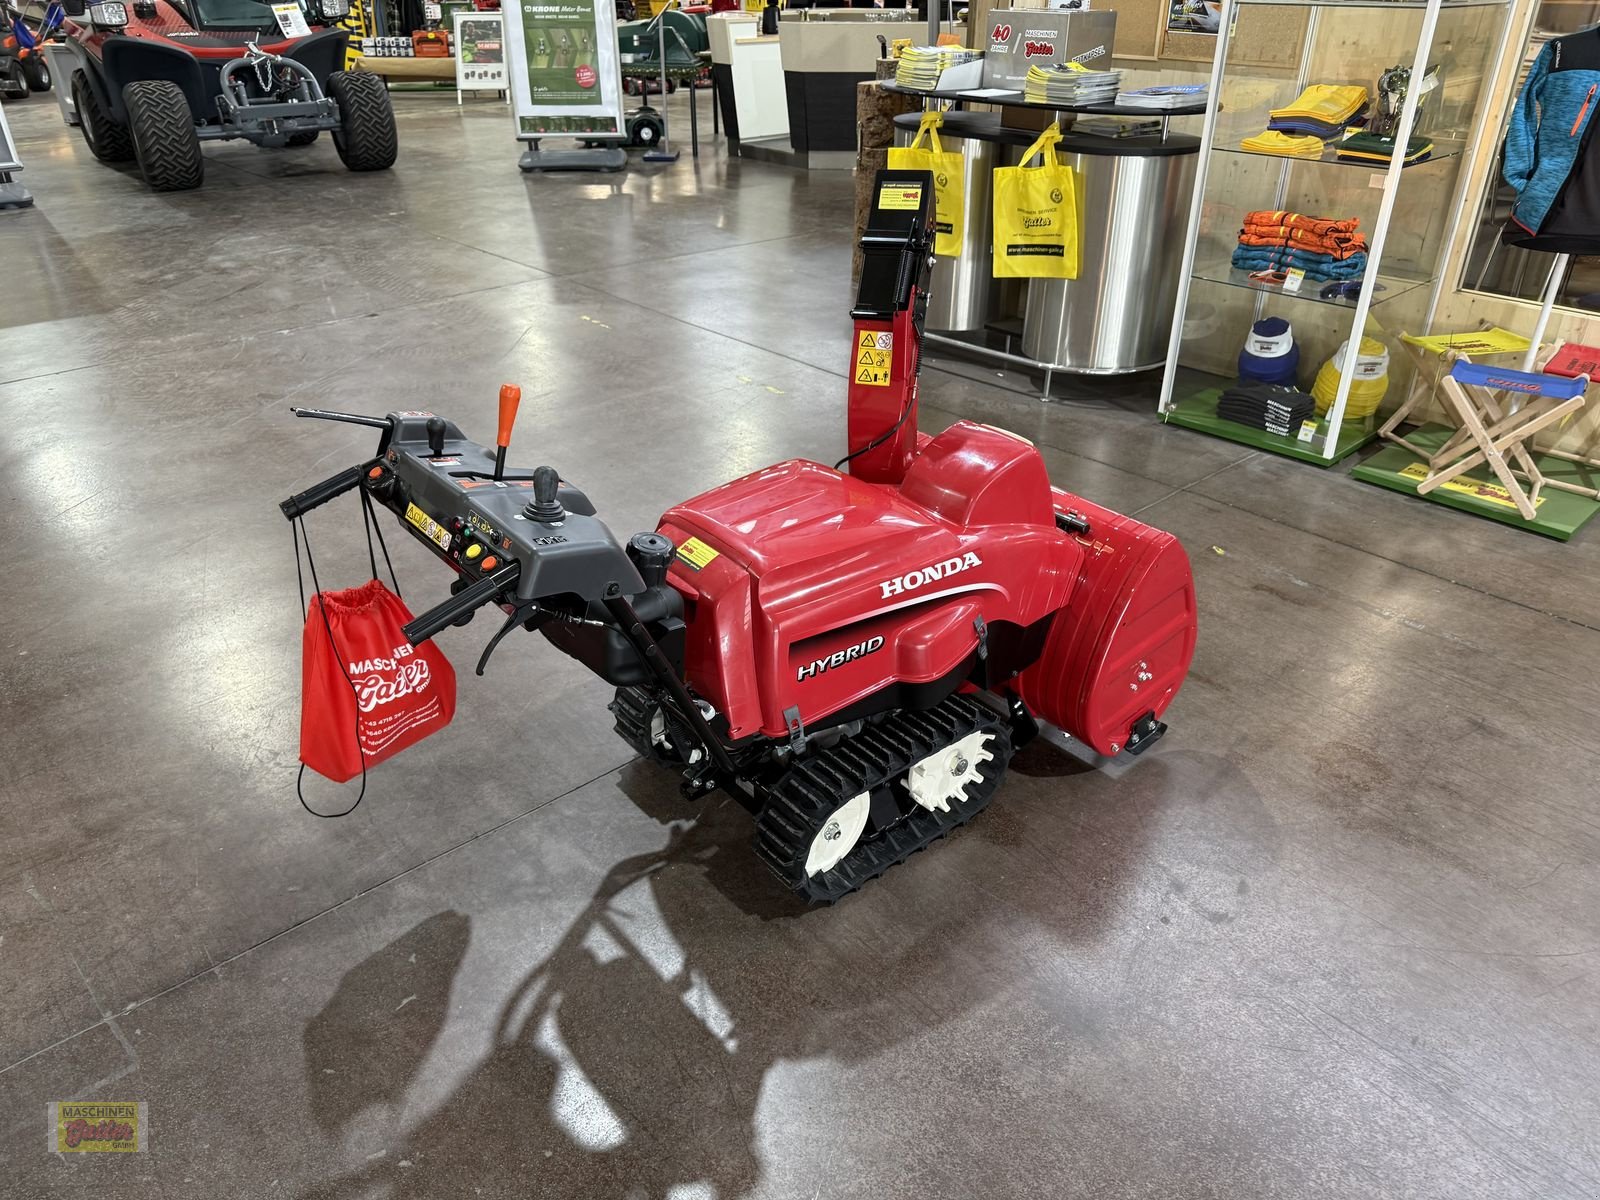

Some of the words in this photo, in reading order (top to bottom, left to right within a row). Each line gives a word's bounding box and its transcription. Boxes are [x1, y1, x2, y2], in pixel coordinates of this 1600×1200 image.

[991, 24, 1011, 42] 40
[880, 552, 982, 599] HONDA
[797, 633, 886, 682] HYBRID
